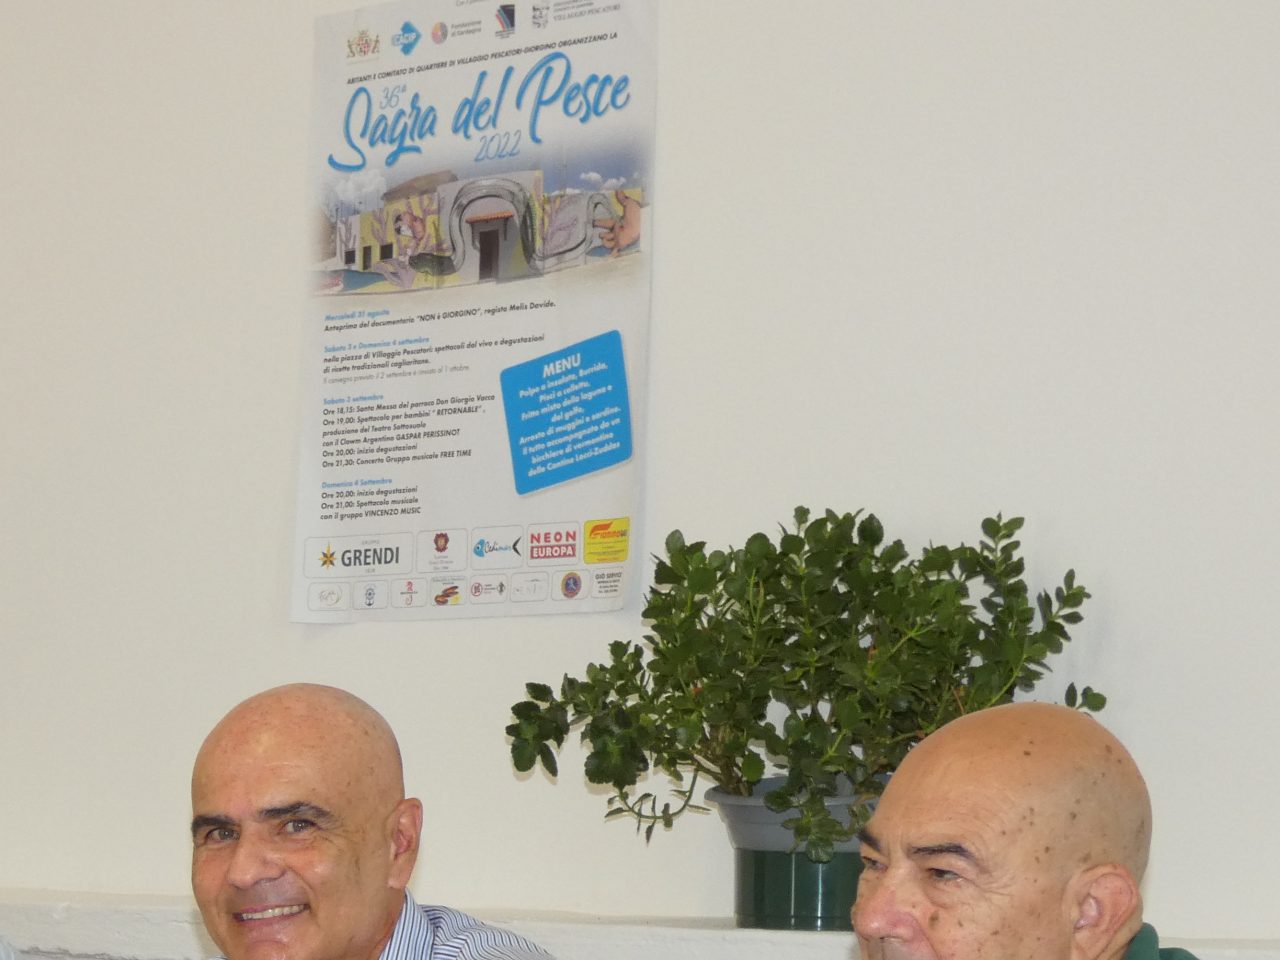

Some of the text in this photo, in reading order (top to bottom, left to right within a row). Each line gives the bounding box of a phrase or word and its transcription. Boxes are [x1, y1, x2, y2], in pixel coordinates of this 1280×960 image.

[347, 74, 371, 85] ABITANTI
[378, 68, 407, 79] COMITATO
[408, 67, 414, 75] DI
[416, 61, 447, 73] QUARTIERE
[457, 54, 489, 65] VILLAGGIO
[558, 34, 608, 48] ORGANIZZANO
[609, 32, 618, 40] LA
[327, 51, 631, 172] Sagra del Pesce
[474, 130, 522, 163] 2022
[324, 323, 358, 333] Anteprima
[359, 320, 370, 329] del
[371, 316, 415, 328] documentario
[484, 305, 507, 316] regista
[340, 353, 362, 364] piazza
[363, 351, 370, 360] di
[372, 349, 401, 359] Villaggio
[434, 342, 465, 353] spettacoli
[466, 340, 477, 349] dal
[479, 339, 492, 347] vivo
[500, 333, 545, 346] degustazioni
[323, 366, 330, 374] di
[352, 360, 389, 371] tradizionali
[543, 352, 582, 378] MENU
[323, 408, 335, 416] Ore
[399, 401, 409, 409] del
[410, 400, 435, 410] parroco
[450, 396, 475, 405] Giorgio
[357, 413, 390, 424] Spettacolo
[391, 413, 403, 422] per
[404, 409, 431, 419] bambini
[322, 428, 359, 438] produzione
[360, 425, 370, 433] del
[396, 431, 421, 441] GASPAR
[519, 430, 546, 445] Arrosto
[556, 416, 584, 433] muggini
[357, 446, 374, 454] inizio
[376, 442, 417, 454] degustazioni
[356, 457, 384, 465] Concerto
[386, 455, 410, 464] Gruppo
[411, 451, 439, 461] musicale
[440, 450, 455, 458] FREE
[456, 449, 472, 457] TIME
[376, 485, 418, 497] degustazioni
[356, 498, 390, 508] Spettacolo
[391, 495, 418, 504] musicale
[340, 511, 363, 521] gruppo
[364, 508, 399, 517] VINCENZO
[400, 506, 421, 514] MUSIC
[530, 530, 577, 544] NEON
[341, 547, 400, 567] GRENDI
[532, 546, 575, 558] EUROPA
